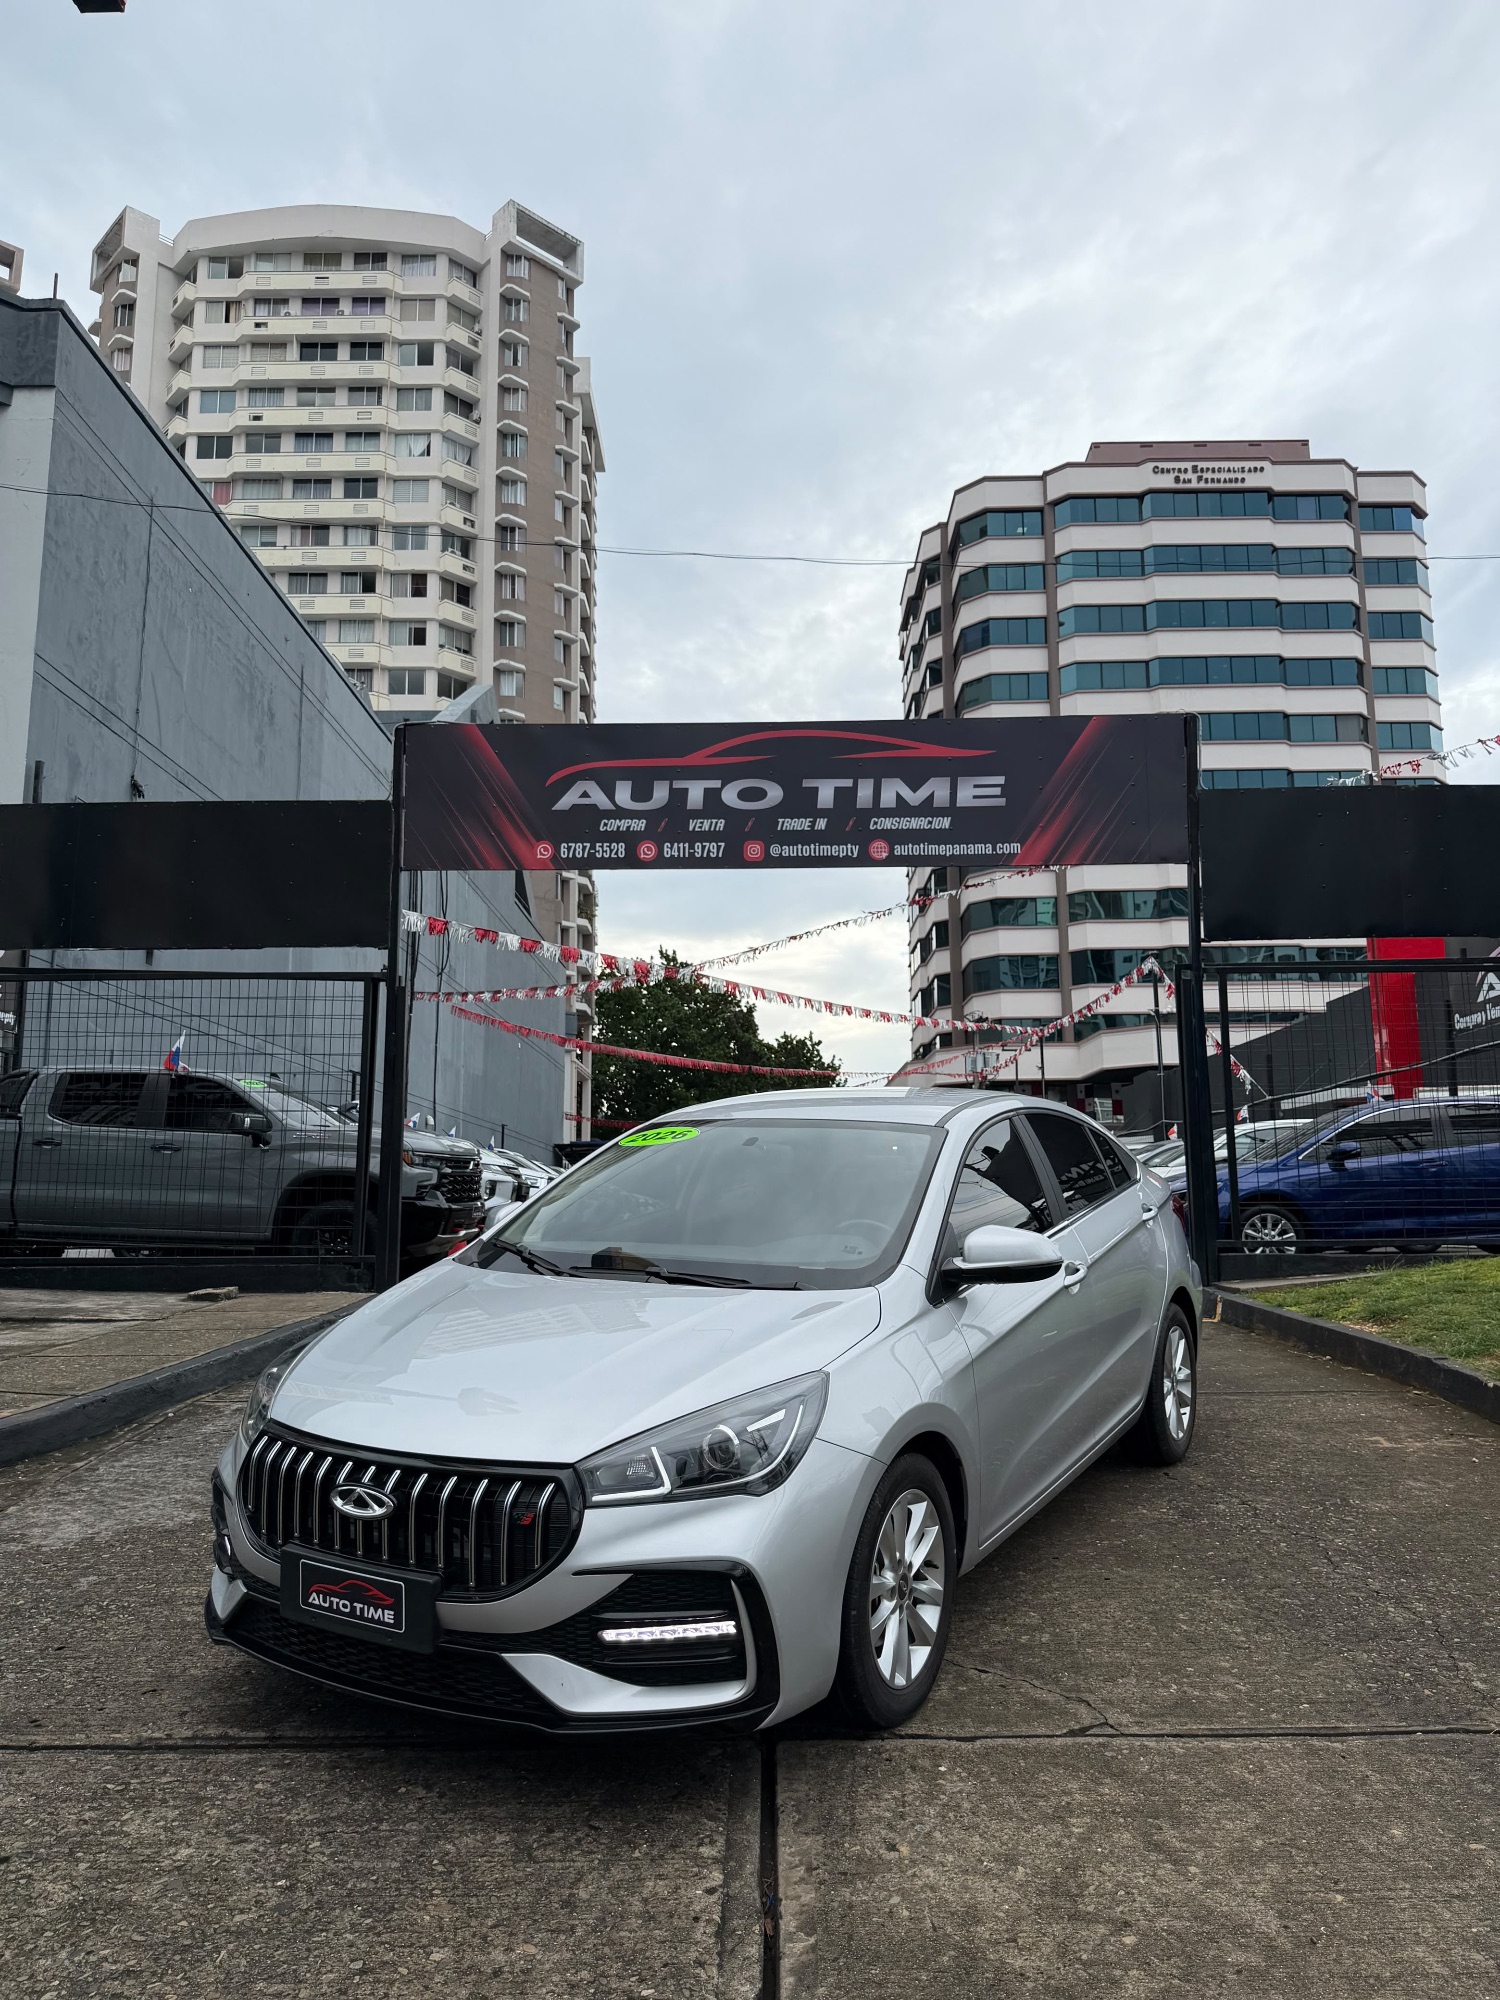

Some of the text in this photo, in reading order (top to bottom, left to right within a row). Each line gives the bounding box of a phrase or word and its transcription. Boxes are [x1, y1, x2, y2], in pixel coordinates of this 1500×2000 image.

[551, 775, 1006, 811] AUTO TIME
[599, 819, 647, 832] COMPRA
[688, 818, 726, 832] VENTA
[776, 818, 813, 831] TRADE
[814, 818, 828, 831] IN
[869, 816, 952, 830] CONSIGNACION
[560, 841, 1022, 858] 6787-5528 6411-9797 @autotimepty autotimepanama.com
[624, 1130, 693, 1143] 2026
[308, 1592, 395, 1624] AUTO TIME
